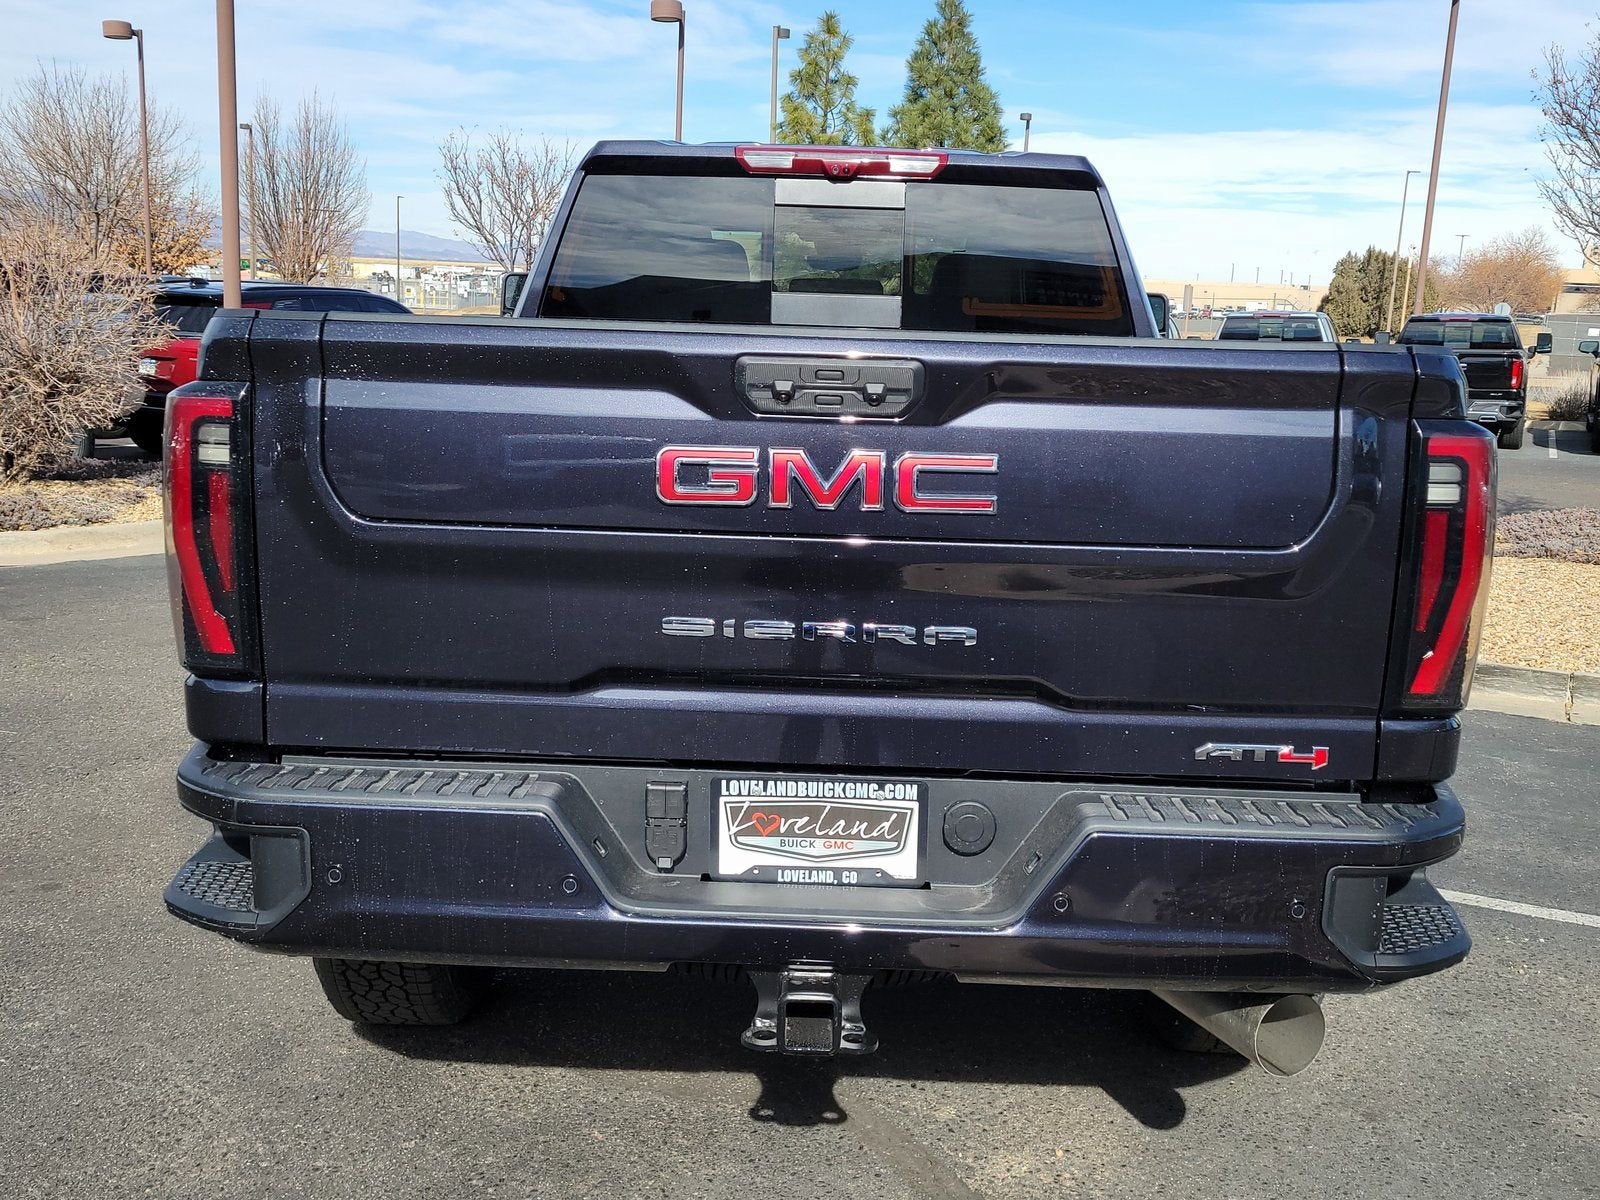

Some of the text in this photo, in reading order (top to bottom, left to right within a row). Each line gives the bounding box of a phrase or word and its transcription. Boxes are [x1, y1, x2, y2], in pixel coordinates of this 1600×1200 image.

[656, 445, 999, 515] GMC
[661, 616, 978, 647] SIERRA
[1195, 742, 1330, 770] AT4
[721, 779, 918, 800] LOVELANDBUICKGMCCOM
[779, 838, 854, 850] BUICK GMC
[777, 869, 857, 884] LOVELAND, CO
